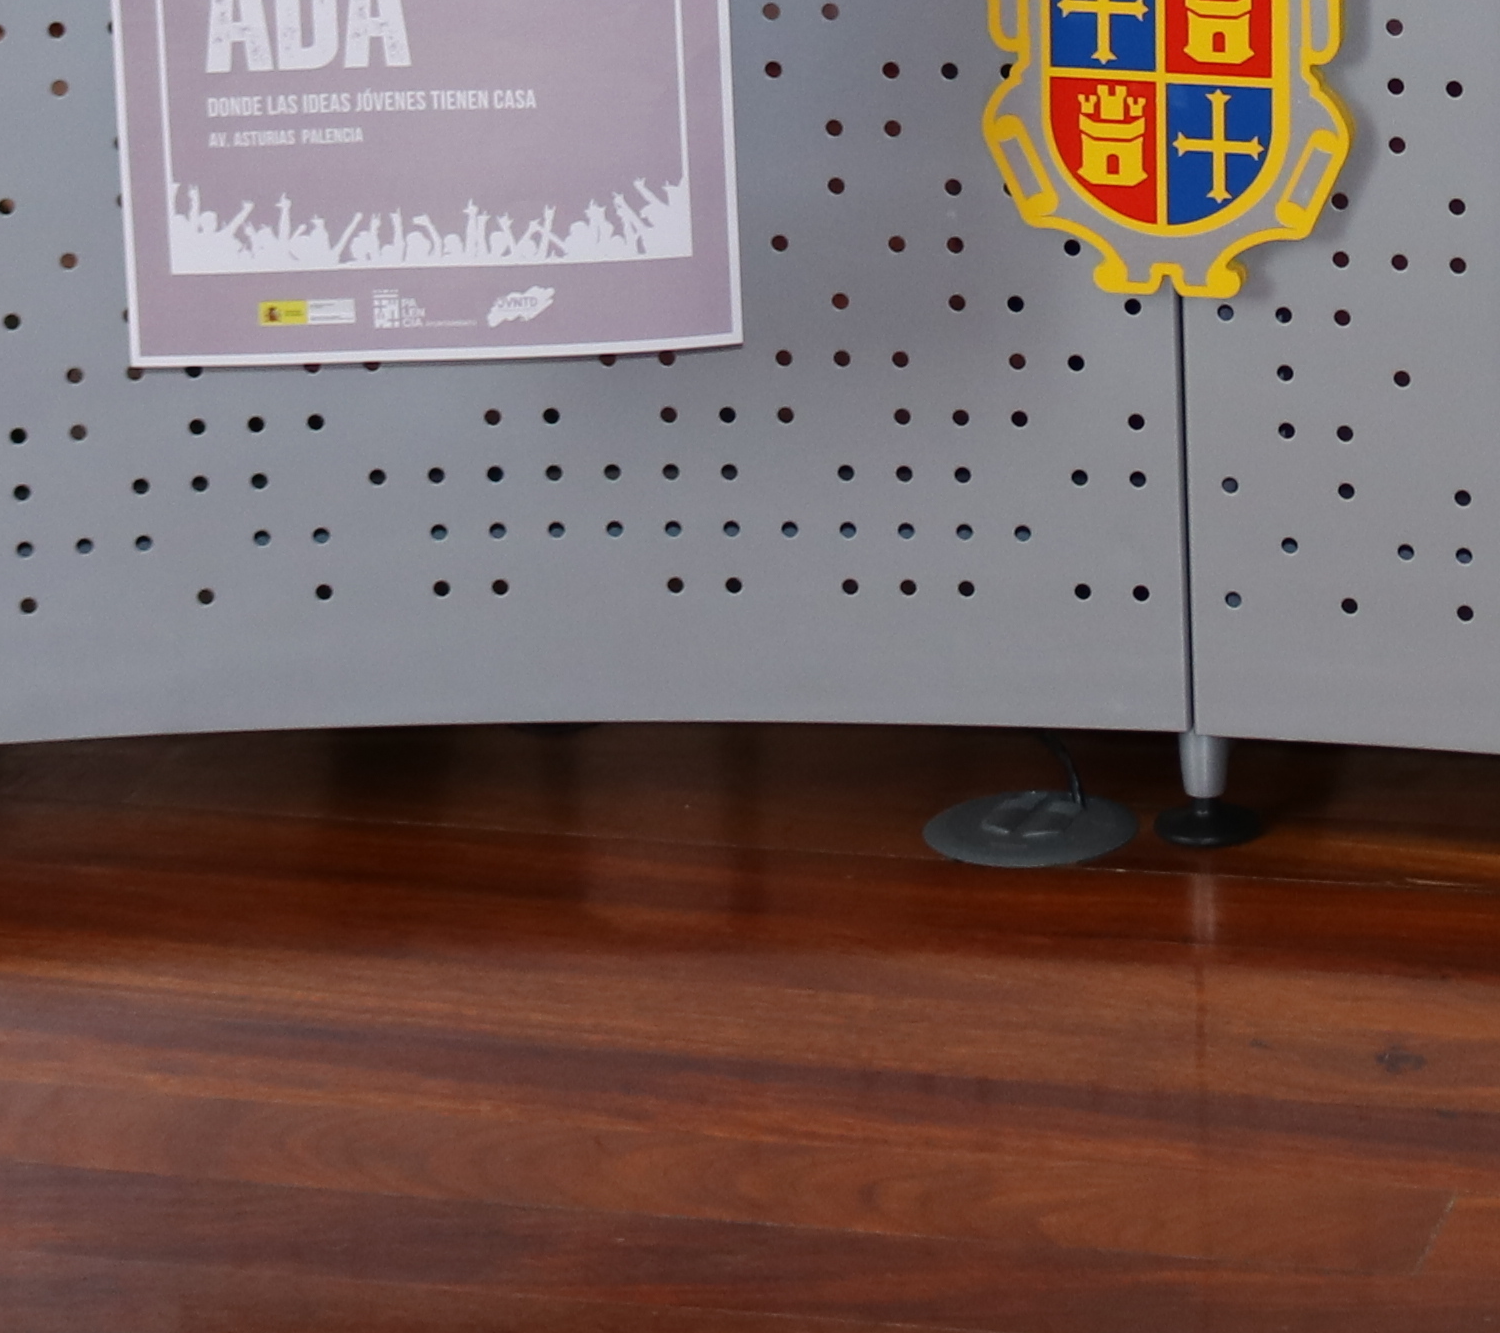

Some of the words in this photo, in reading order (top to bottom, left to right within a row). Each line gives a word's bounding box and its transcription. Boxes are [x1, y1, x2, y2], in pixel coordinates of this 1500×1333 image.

[207, 96, 263, 118] DONDE
[266, 94, 298, 116] LAS
[302, 92, 351, 114] IDEAS
[354, 88, 427, 112] JÓVENES
[430, 90, 489, 111] TIENEN
[493, 89, 537, 109] CASA
[208, 131, 230, 148] AV.
[233, 130, 296, 147] ASTURIAS
[302, 127, 364, 144] PALENCIA
